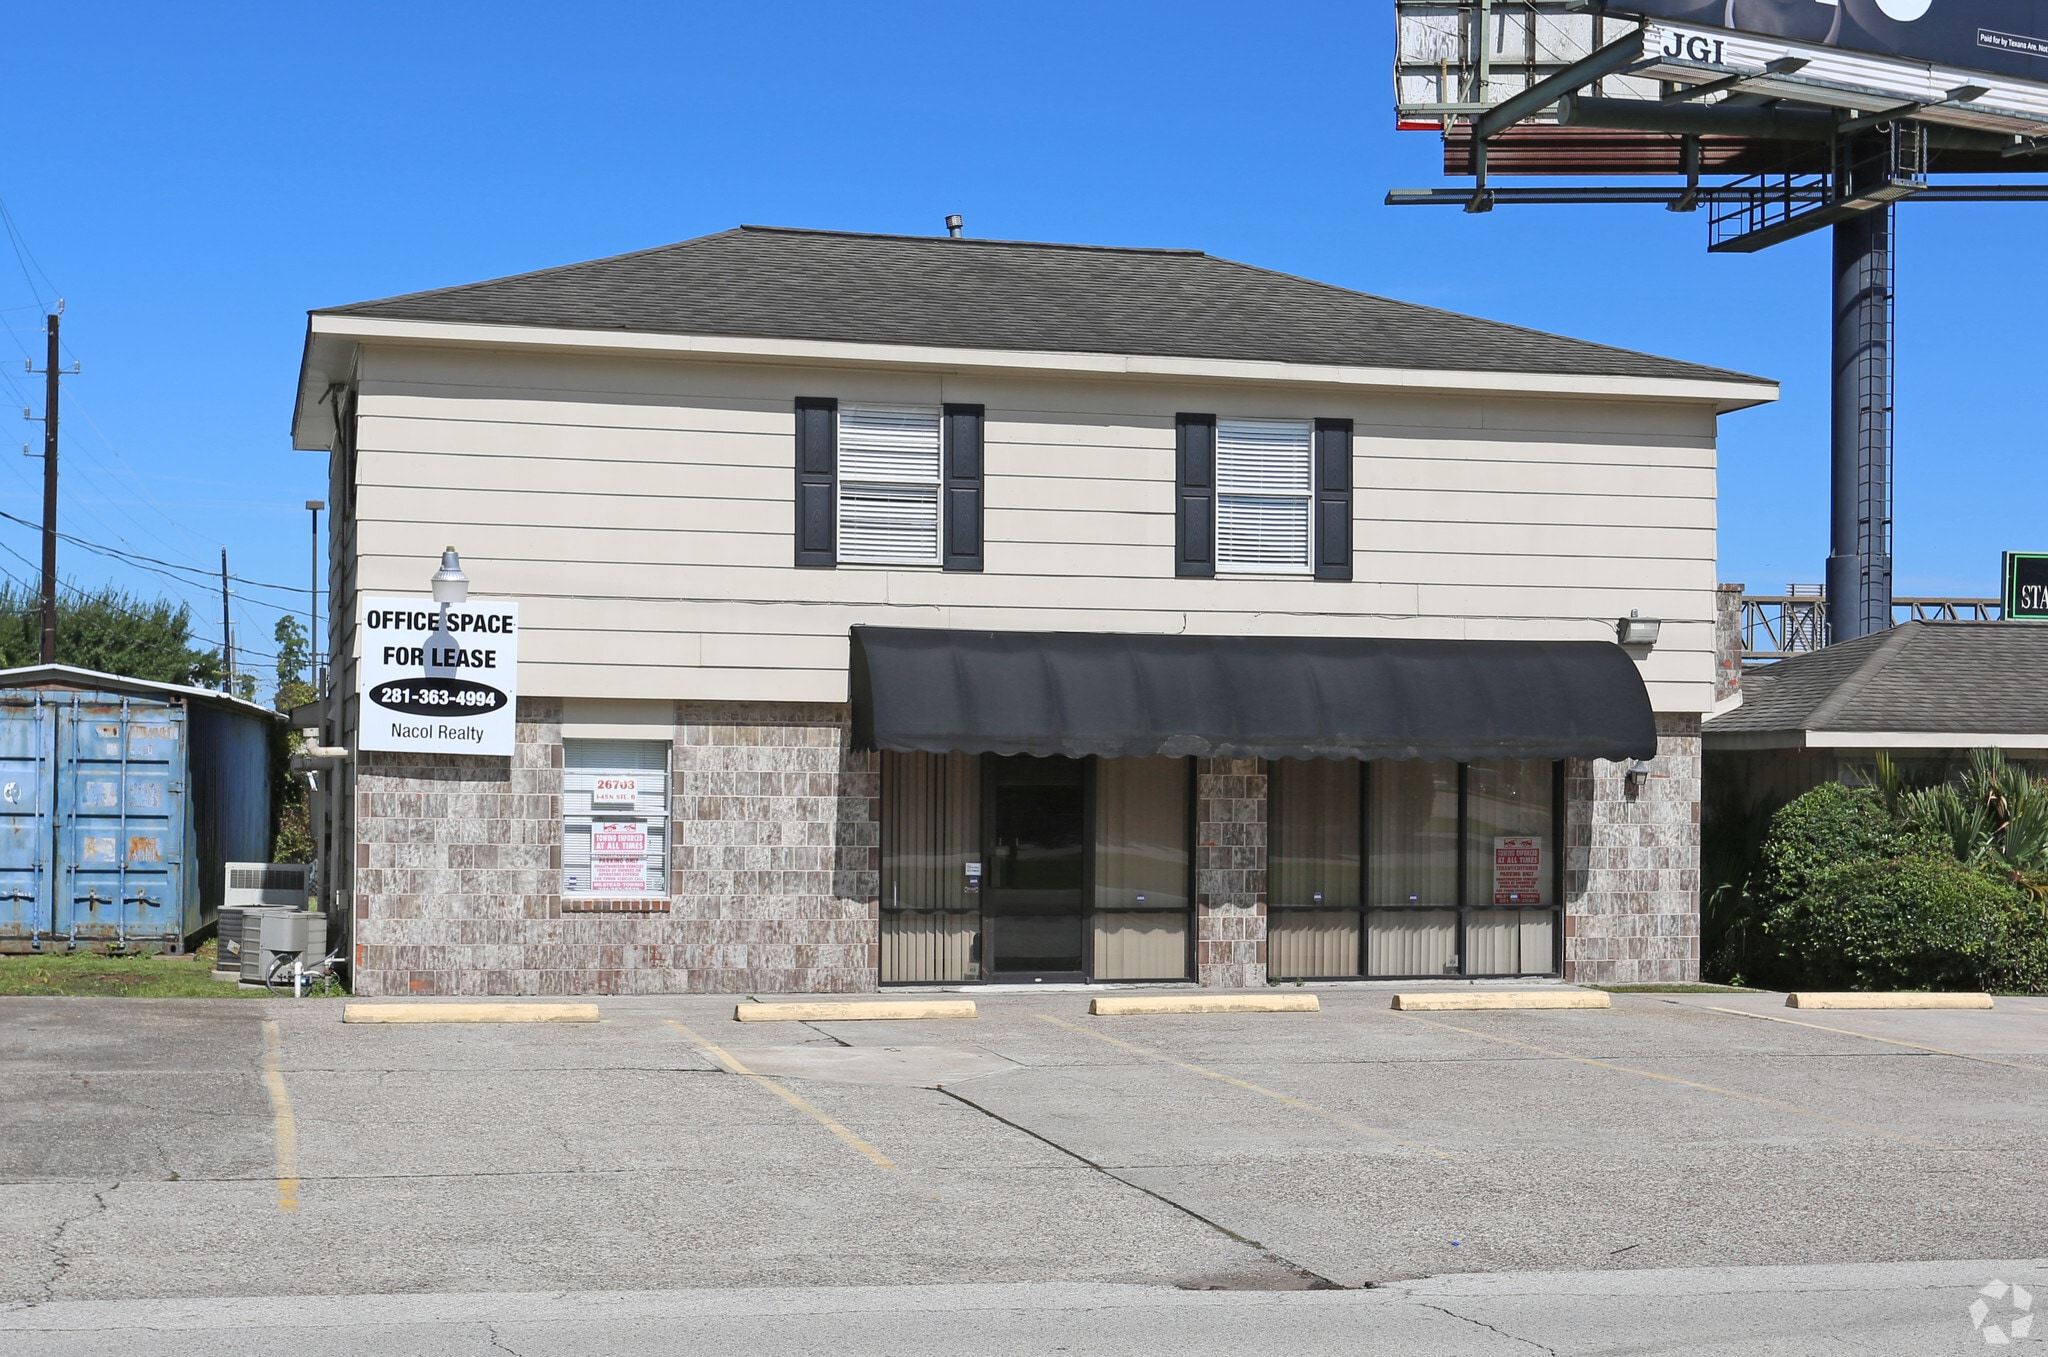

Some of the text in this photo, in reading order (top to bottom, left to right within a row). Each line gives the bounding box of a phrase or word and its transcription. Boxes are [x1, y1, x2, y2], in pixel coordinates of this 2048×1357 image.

[1664, 32, 1724, 65] JGI
[1980, 33, 1992, 43] Paid
[2001, 37, 2008, 47] by
[2008, 39, 2026, 49] Texans
[2027, 42, 2037, 51] Are.
[367, 610, 513, 634] OFFICE SPACE
[383, 646, 496, 668] FOR LEASE
[381, 687, 496, 707] 281-363-4994
[391, 723, 484, 744] Nacol Realty
[597, 779, 635, 790] 26703
[596, 834, 644, 842] TOWING ENFORCED
[622, 842, 643, 850] TIMES
